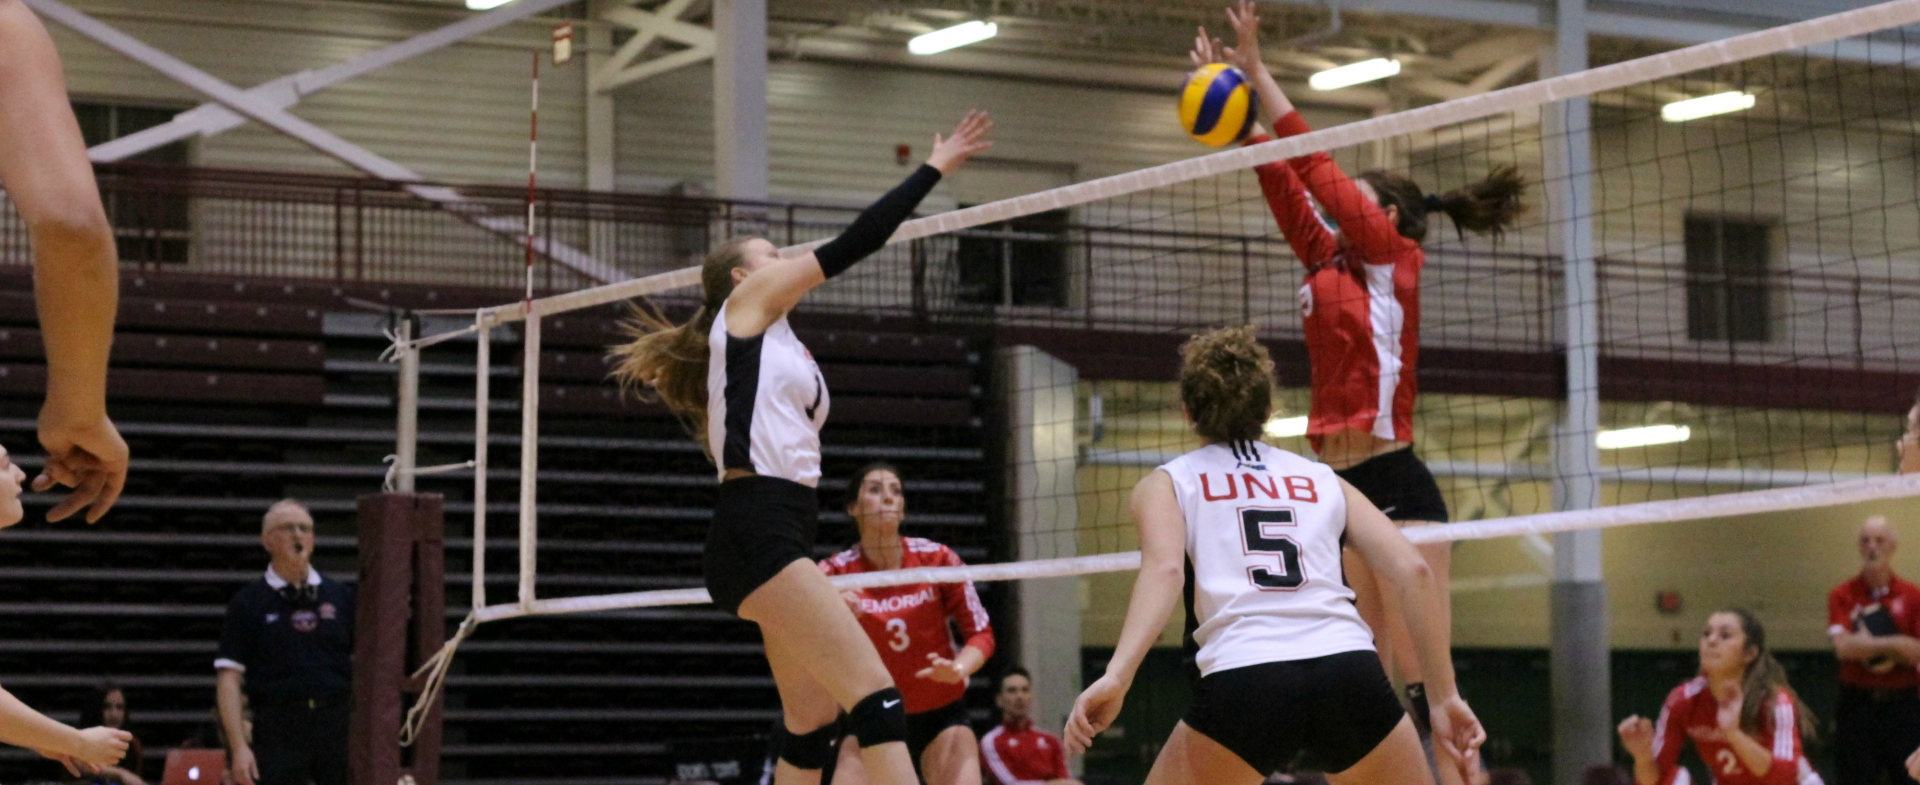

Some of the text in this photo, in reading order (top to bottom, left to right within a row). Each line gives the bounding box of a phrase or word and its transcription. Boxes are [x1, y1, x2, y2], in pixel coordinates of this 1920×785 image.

[1199, 472, 1319, 504] UNB
[1236, 505, 1309, 592] 5
[858, 587, 935, 614] EMORIAL
[885, 617, 911, 652] 3
[1715, 748, 1743, 775] 2
